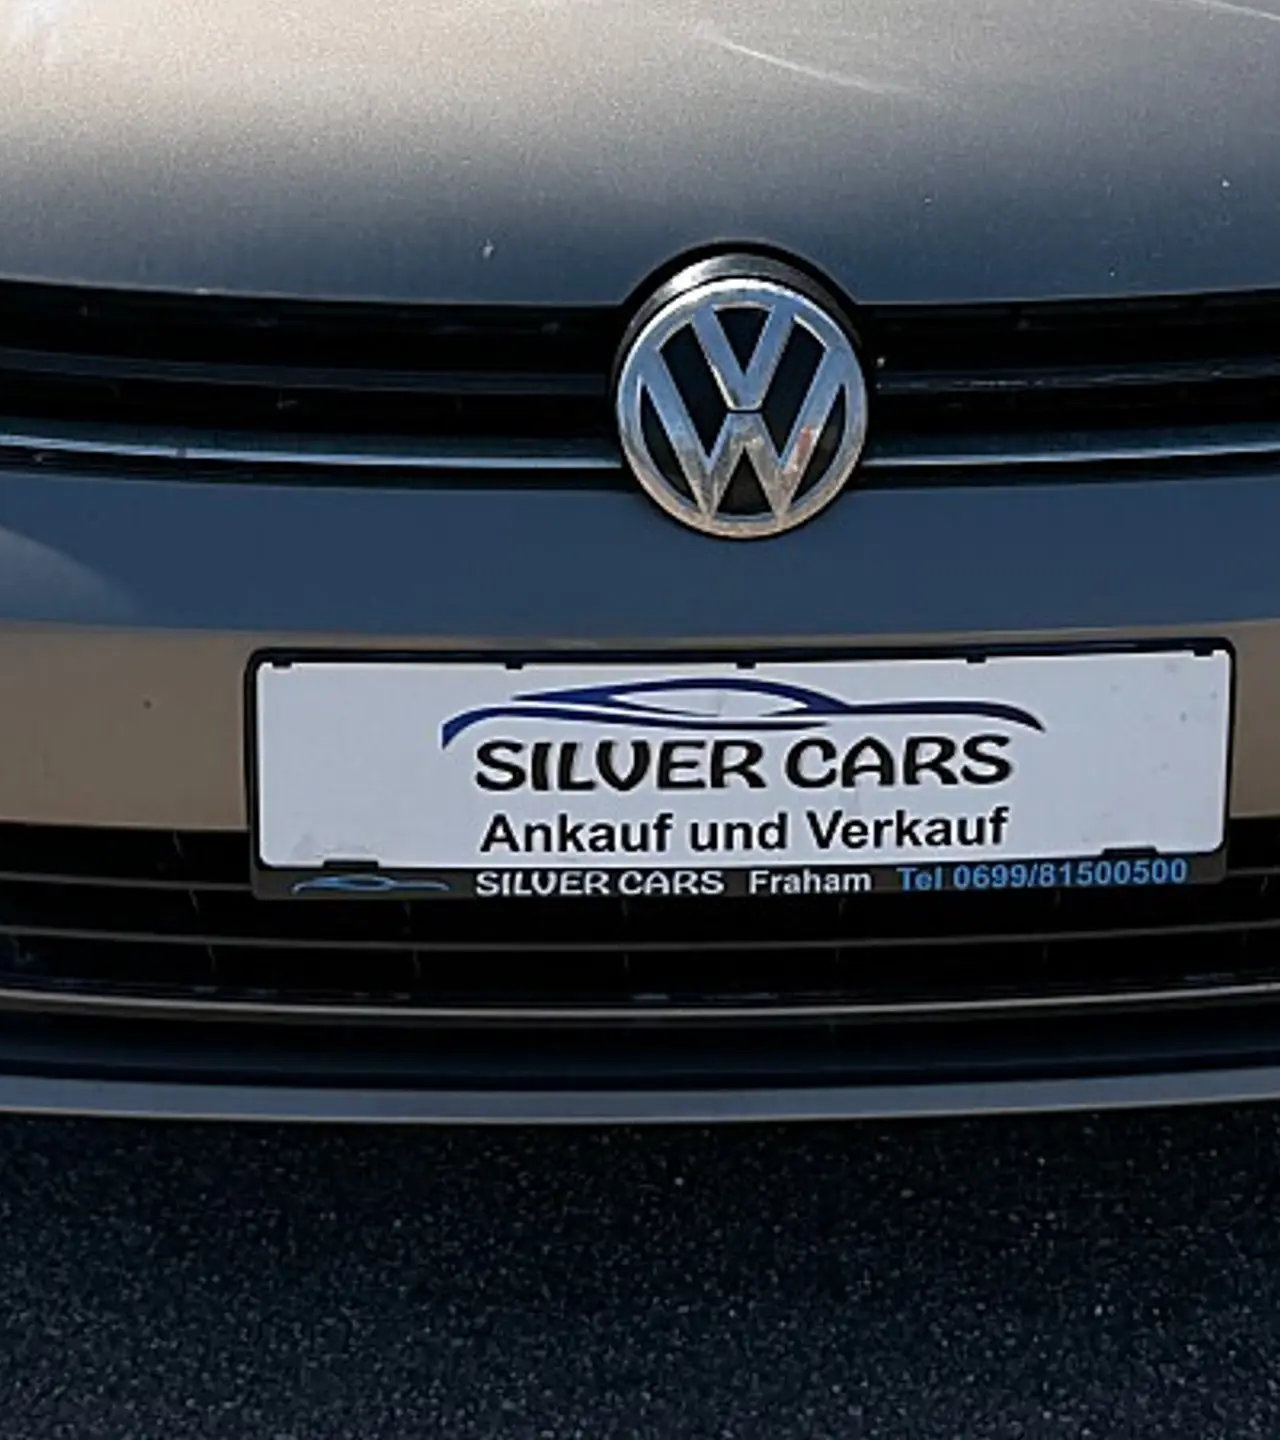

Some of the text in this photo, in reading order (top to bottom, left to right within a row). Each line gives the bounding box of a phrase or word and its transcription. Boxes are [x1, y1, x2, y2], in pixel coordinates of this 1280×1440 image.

[475, 734, 1013, 792] SILVER CARS
[480, 806, 1010, 853] Ankauf und Verkauf
[475, 858, 1189, 897] SILVER CARS Fraham Tel 0699/81500500
